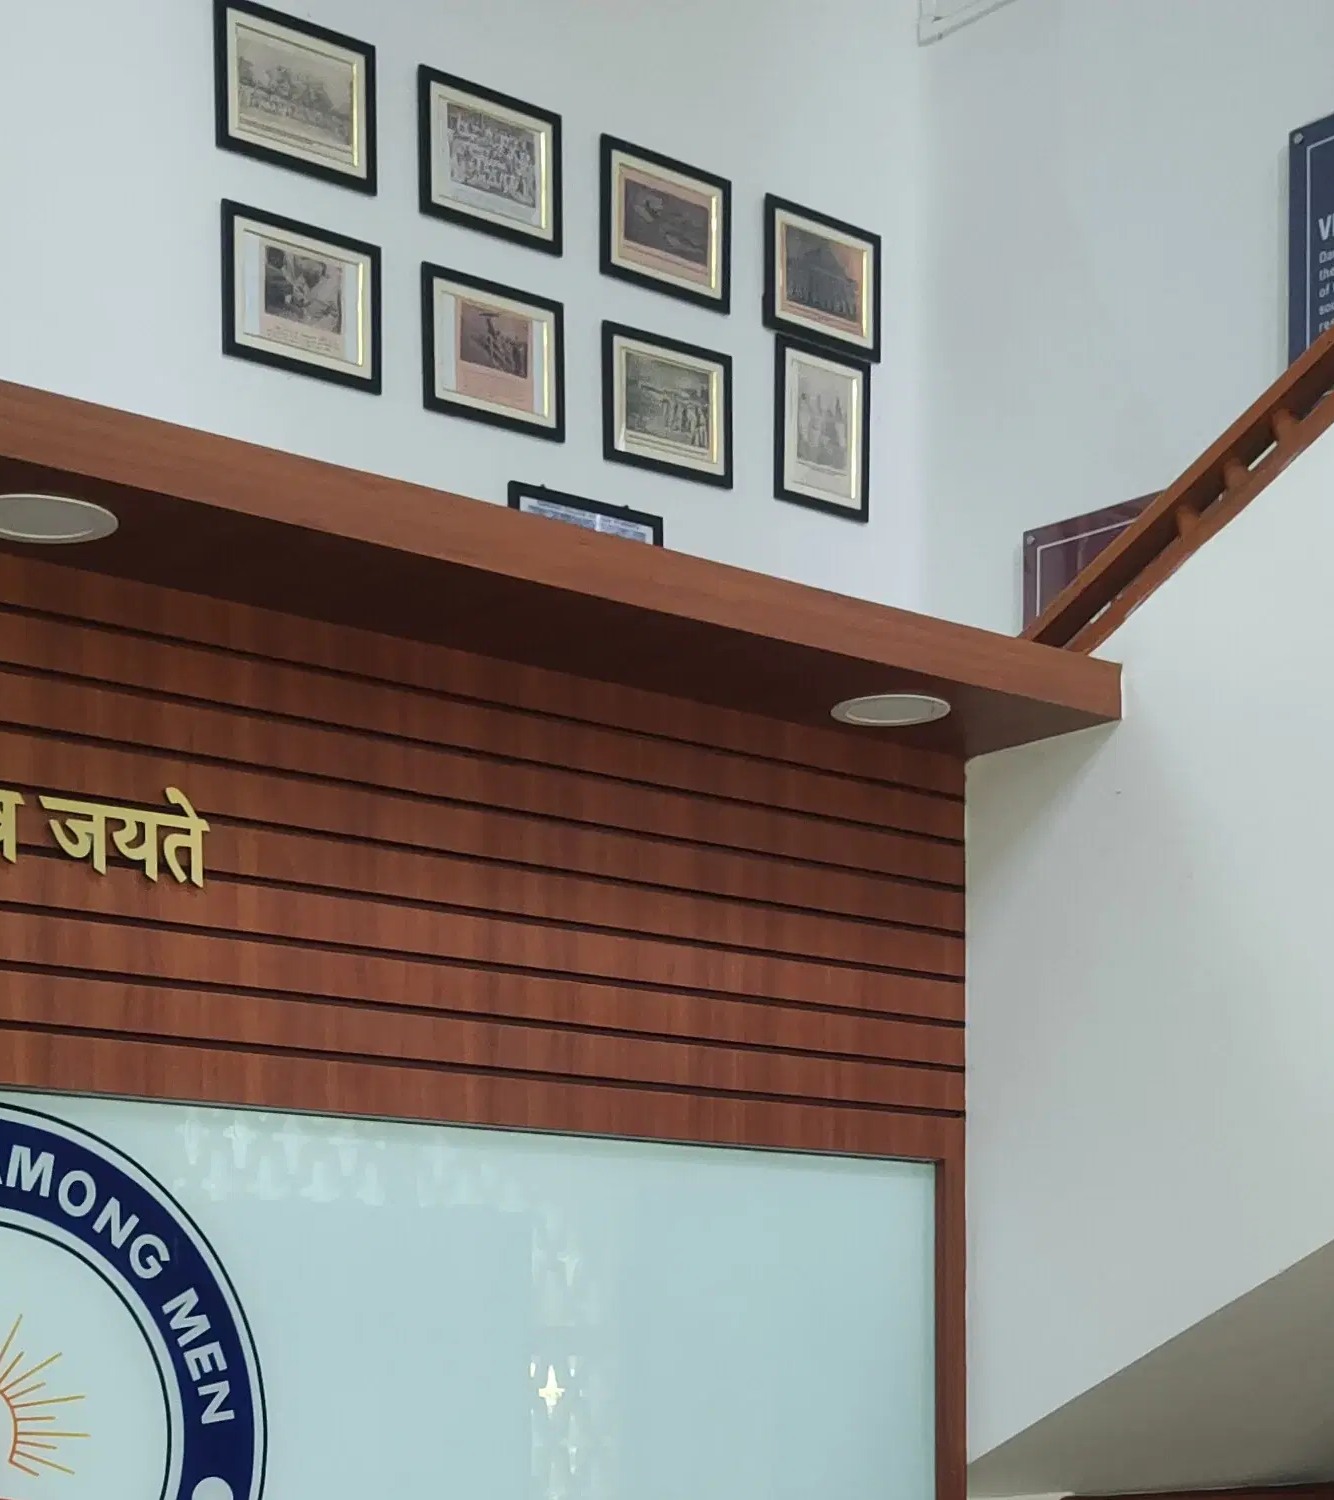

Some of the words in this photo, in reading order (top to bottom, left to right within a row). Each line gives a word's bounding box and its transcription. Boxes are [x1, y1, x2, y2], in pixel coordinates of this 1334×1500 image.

[1319, 282, 1330, 298] of
[39, 787, 210, 888] जयते
[162, 1287, 235, 1426] MEN
